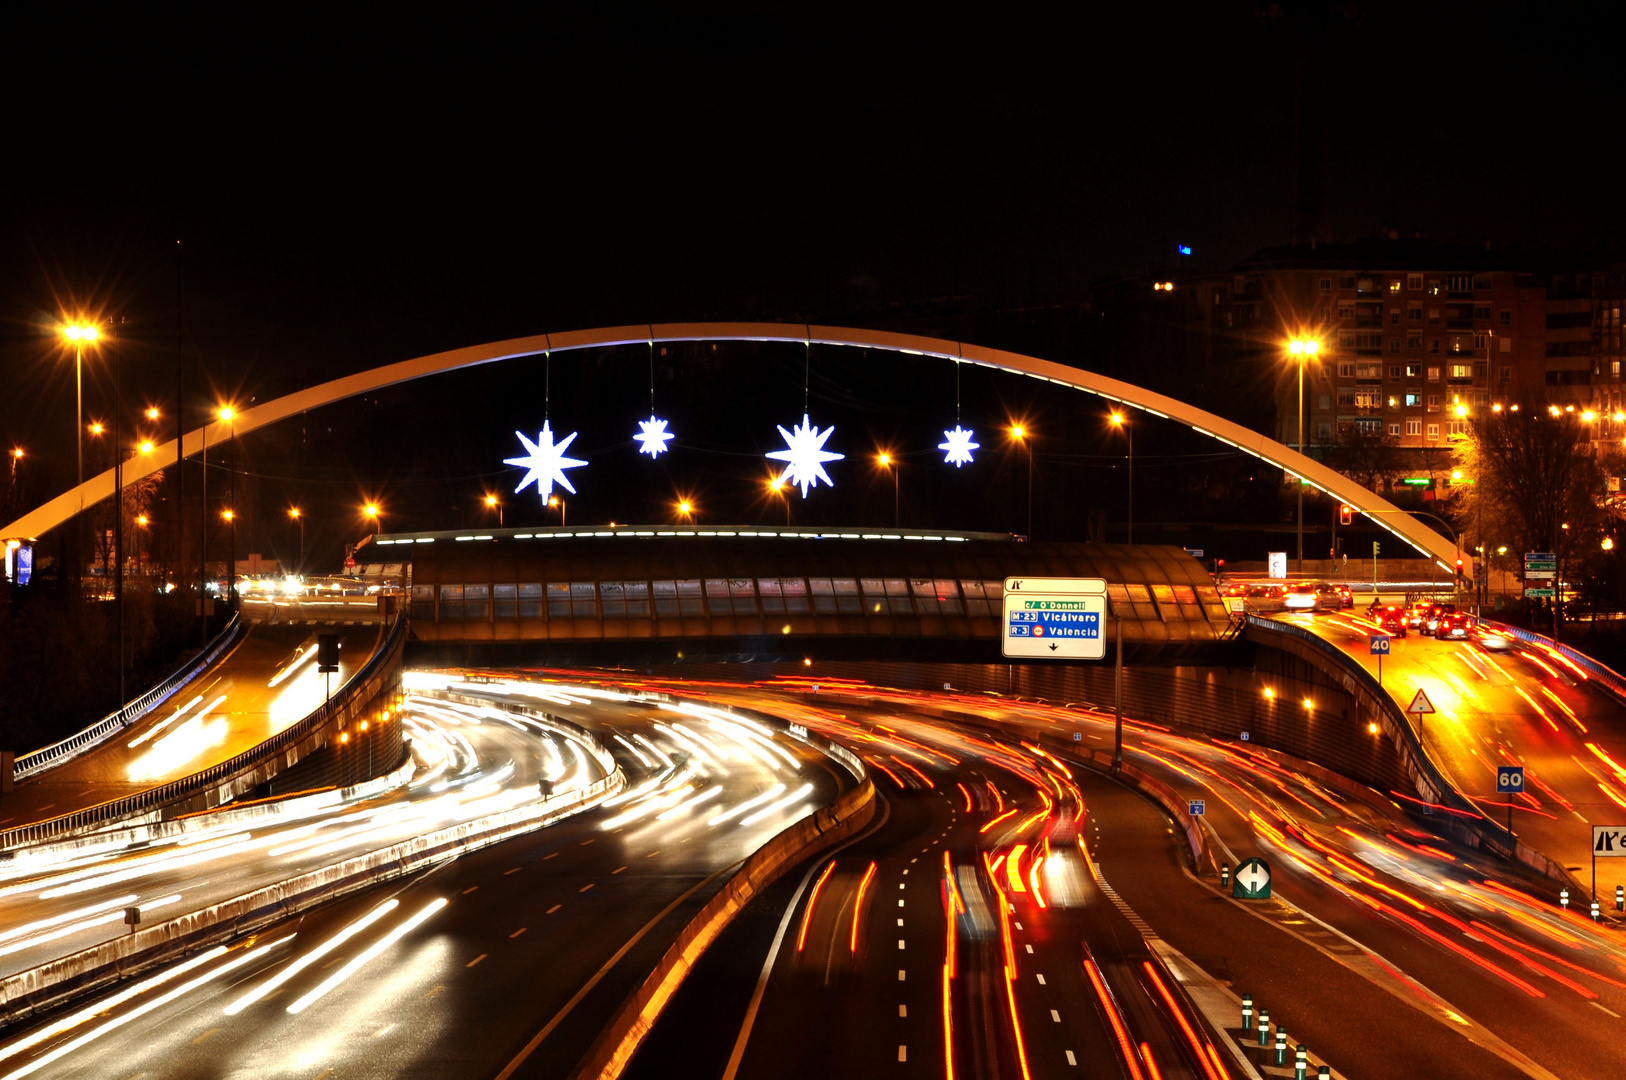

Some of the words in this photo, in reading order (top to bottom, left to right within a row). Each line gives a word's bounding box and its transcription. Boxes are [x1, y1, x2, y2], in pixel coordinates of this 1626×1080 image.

[1025, 601, 1036, 609] c/
[1040, 602, 1085, 610] O'Donnell
[1012, 612, 1036, 620] M-23
[1042, 612, 1097, 622] Vicálvaro
[1011, 627, 1028, 635] R-3
[1049, 627, 1097, 636] Valencia
[1371, 640, 1389, 650] 40
[1499, 773, 1522, 787] 60
